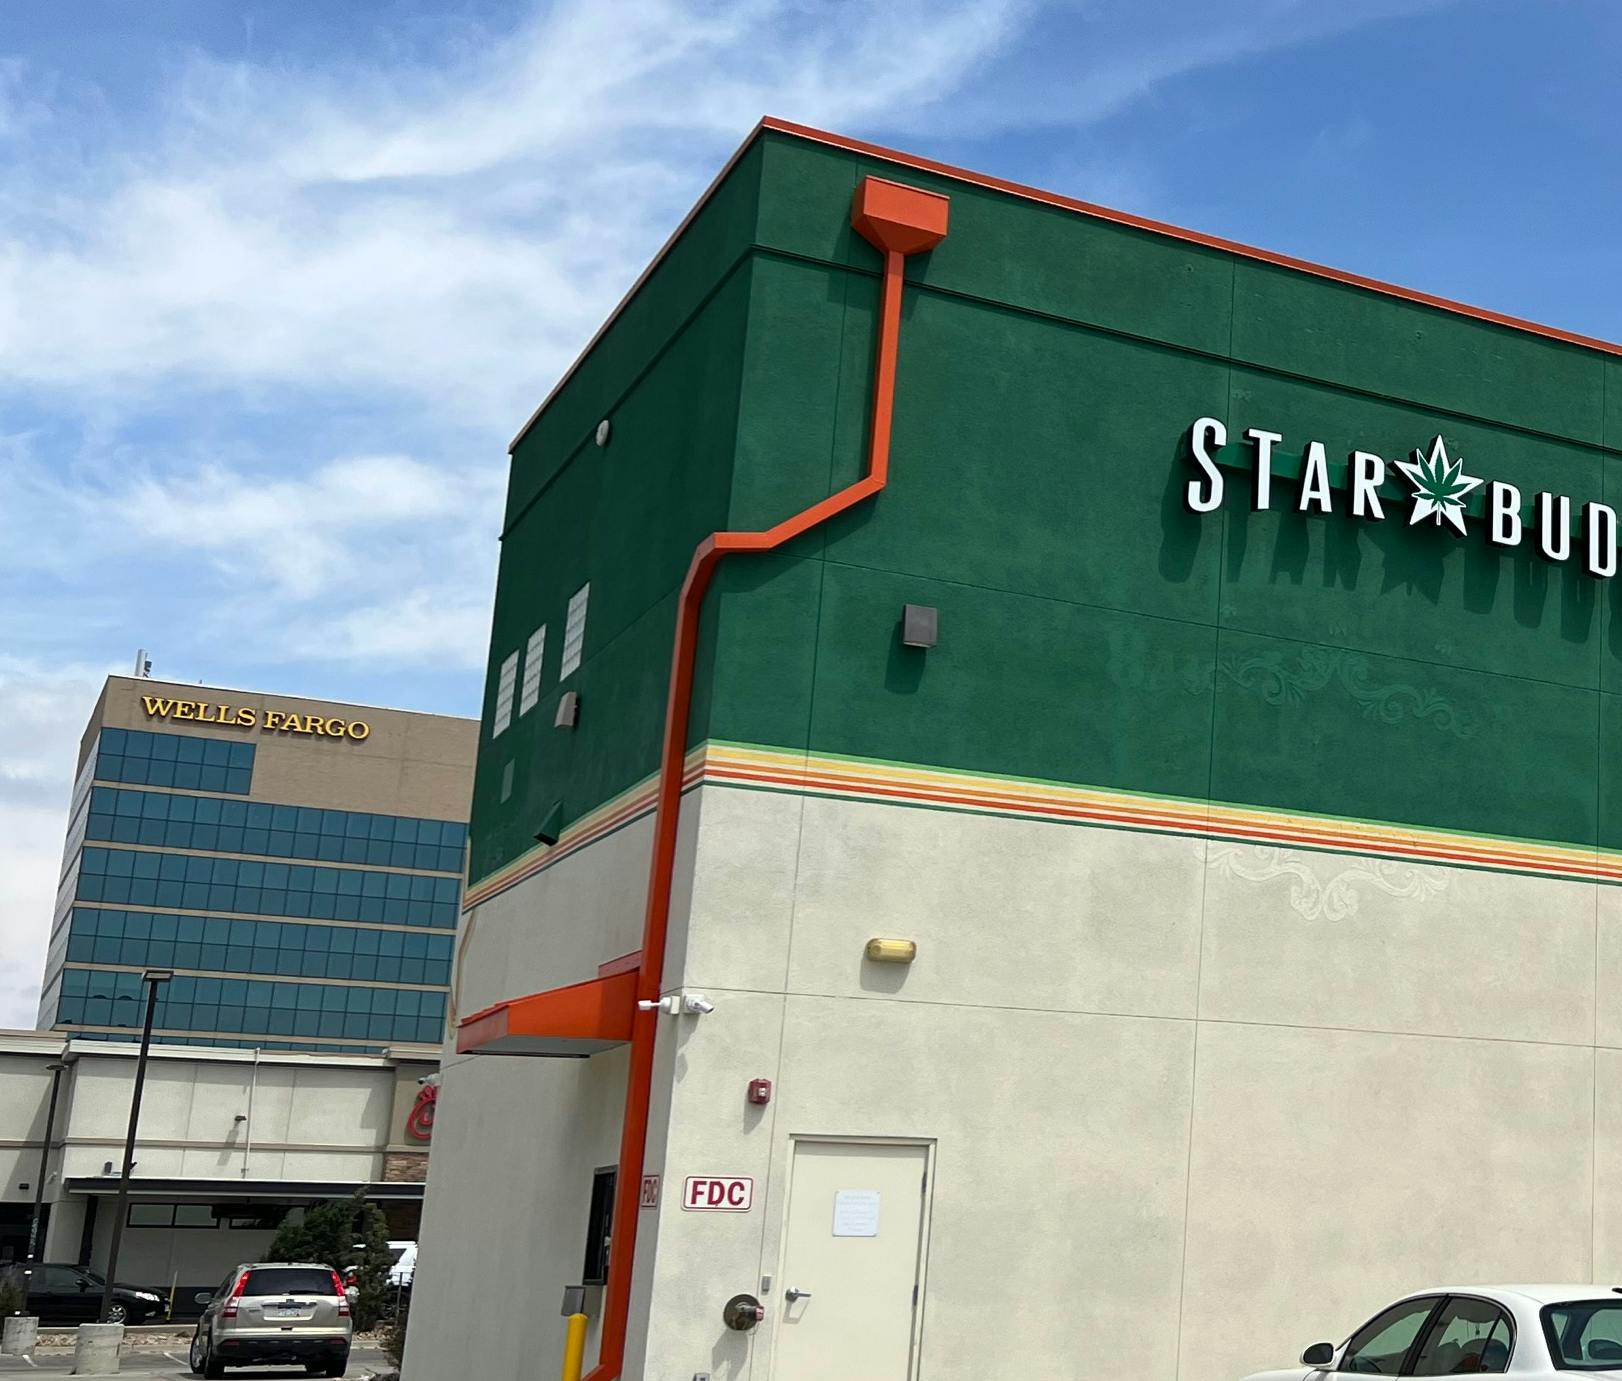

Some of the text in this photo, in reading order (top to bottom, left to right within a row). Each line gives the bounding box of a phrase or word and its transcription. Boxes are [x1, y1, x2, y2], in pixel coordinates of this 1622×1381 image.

[1186, 416, 1385, 520] STAR
[142, 696, 371, 740] WELLS FARGO
[690, 1180, 746, 1206] FDC
